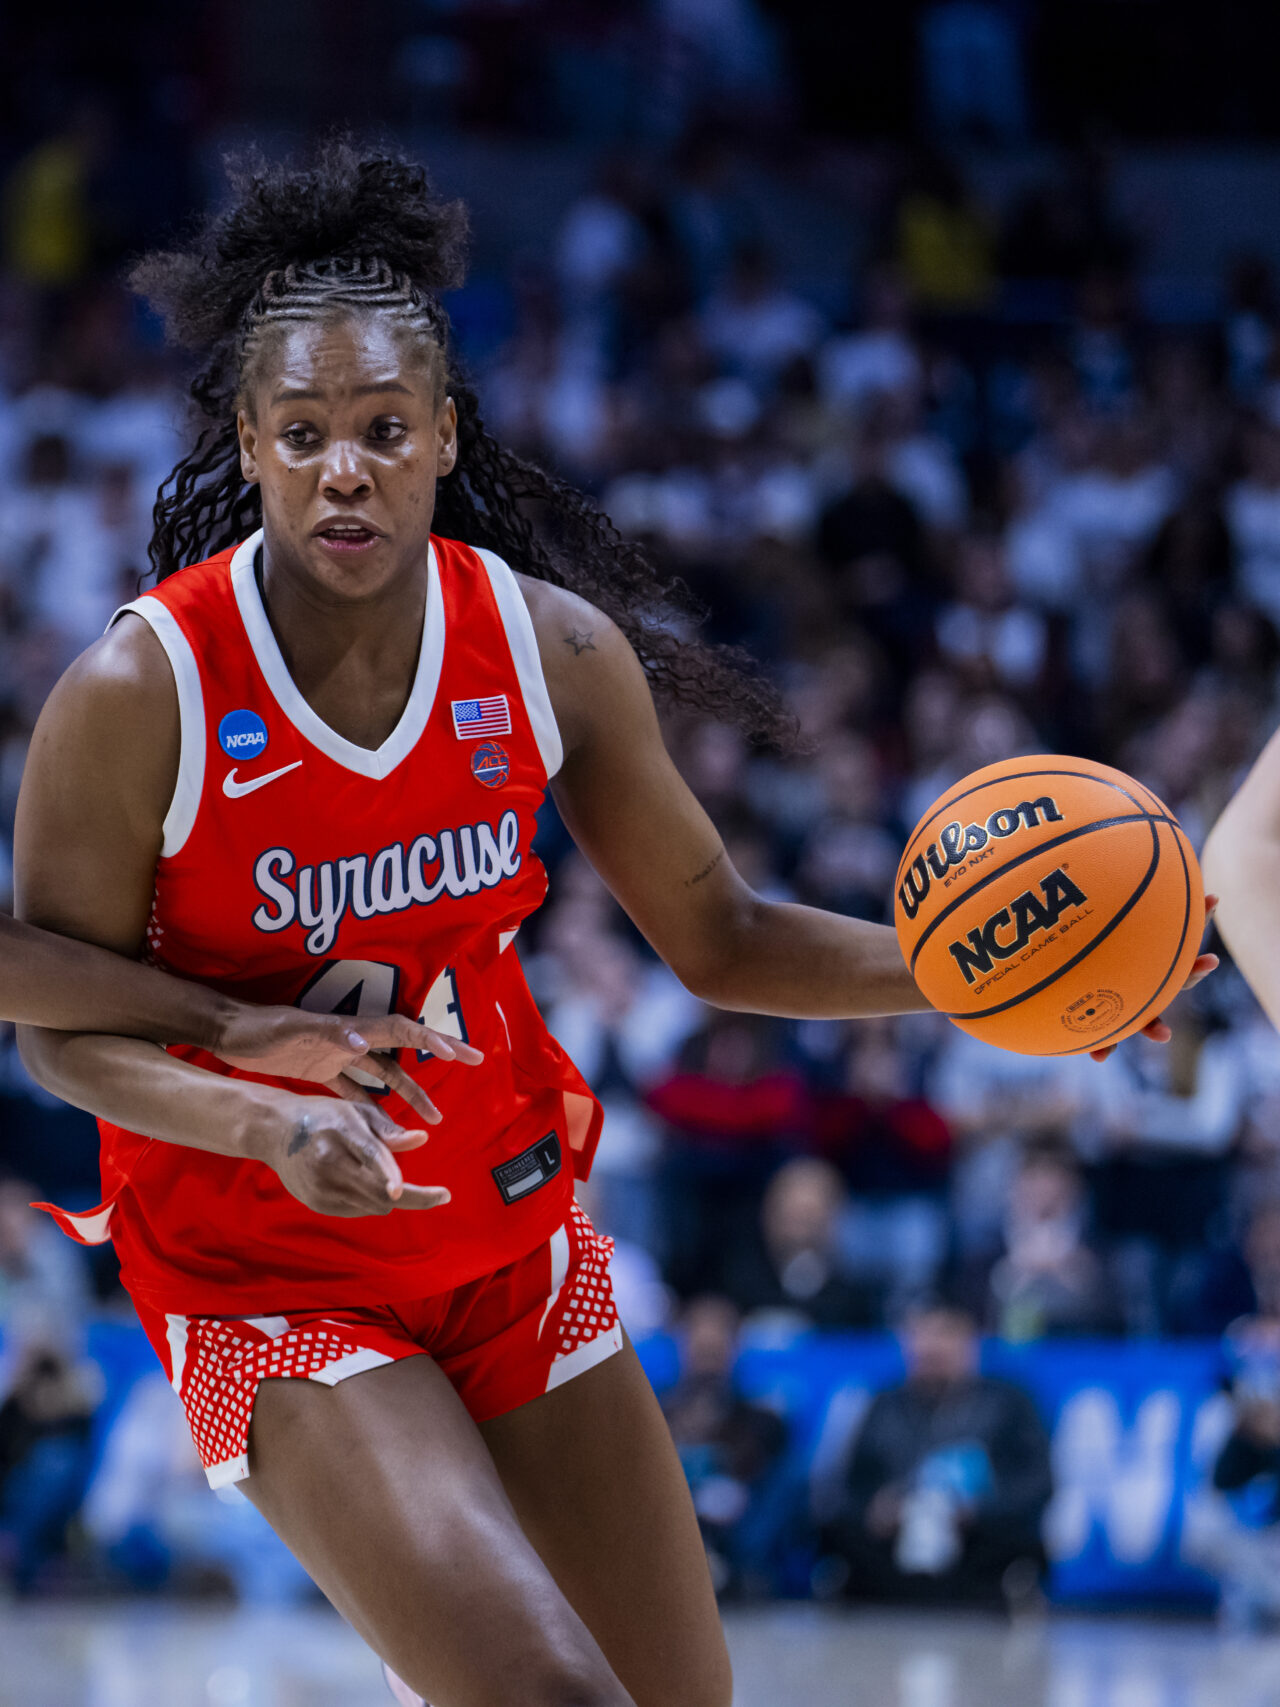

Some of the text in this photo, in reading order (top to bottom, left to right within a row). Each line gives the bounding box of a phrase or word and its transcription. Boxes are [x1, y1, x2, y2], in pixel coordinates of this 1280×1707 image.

[225, 731, 266, 749] NCAA
[476, 754, 508, 770] ACC
[251, 808, 522, 956] Syracuse
[898, 795, 1065, 921] Wilson
[943, 846, 996, 889] EVO NXT
[947, 867, 1089, 985] NCAA
[973, 906, 1095, 996] OFFICIAL GAME BALL
[543, 1150, 556, 1166] L
